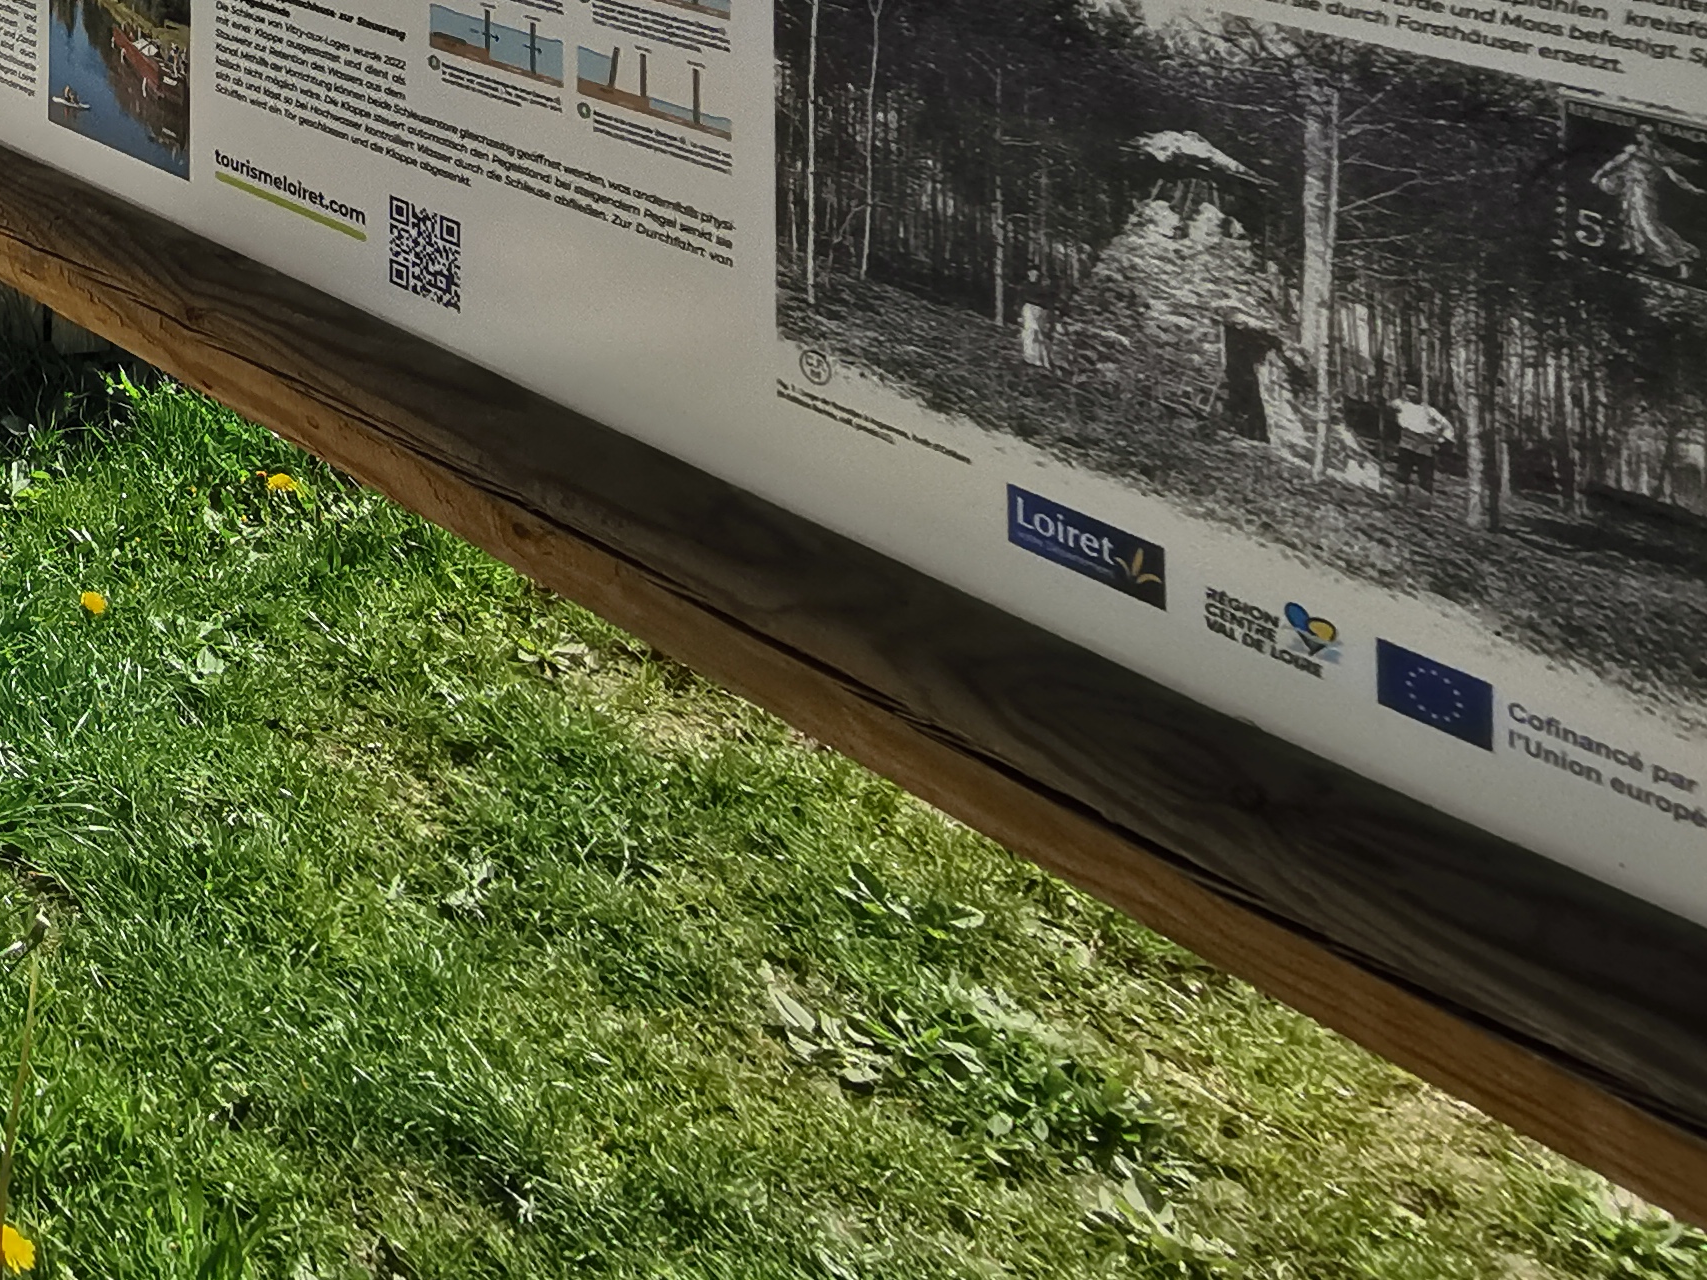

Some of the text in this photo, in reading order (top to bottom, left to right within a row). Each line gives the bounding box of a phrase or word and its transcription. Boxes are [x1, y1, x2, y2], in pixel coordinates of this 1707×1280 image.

[1325, 1, 1389, 26] durch
[1395, 14, 1534, 54] Forsthäuser
[214, 149, 367, 226] tourismeloiret.com
[1016, 495, 1115, 565] Loiret
[1204, 603, 1277, 644] CENTRE
[1204, 614, 1325, 680] VAL DE LOIRE
[1508, 702, 1700, 793] Cofinancé par
[1508, 729, 1605, 786] l'Union
